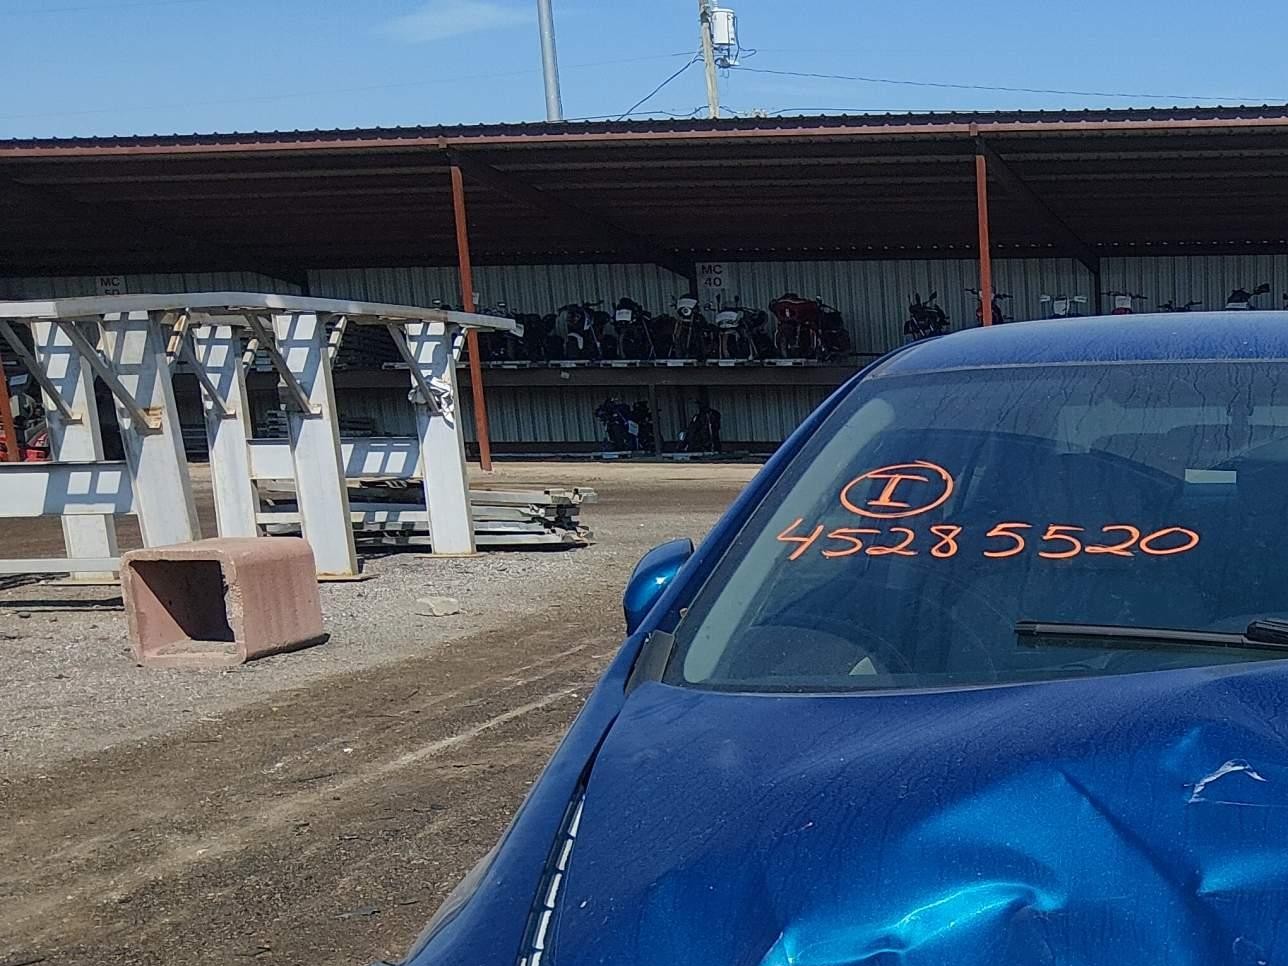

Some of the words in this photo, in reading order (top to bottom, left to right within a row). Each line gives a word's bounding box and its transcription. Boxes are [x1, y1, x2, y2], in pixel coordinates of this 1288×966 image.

[701, 264, 723, 274] MC
[100, 277, 121, 287] MC
[704, 277, 722, 287] 40
